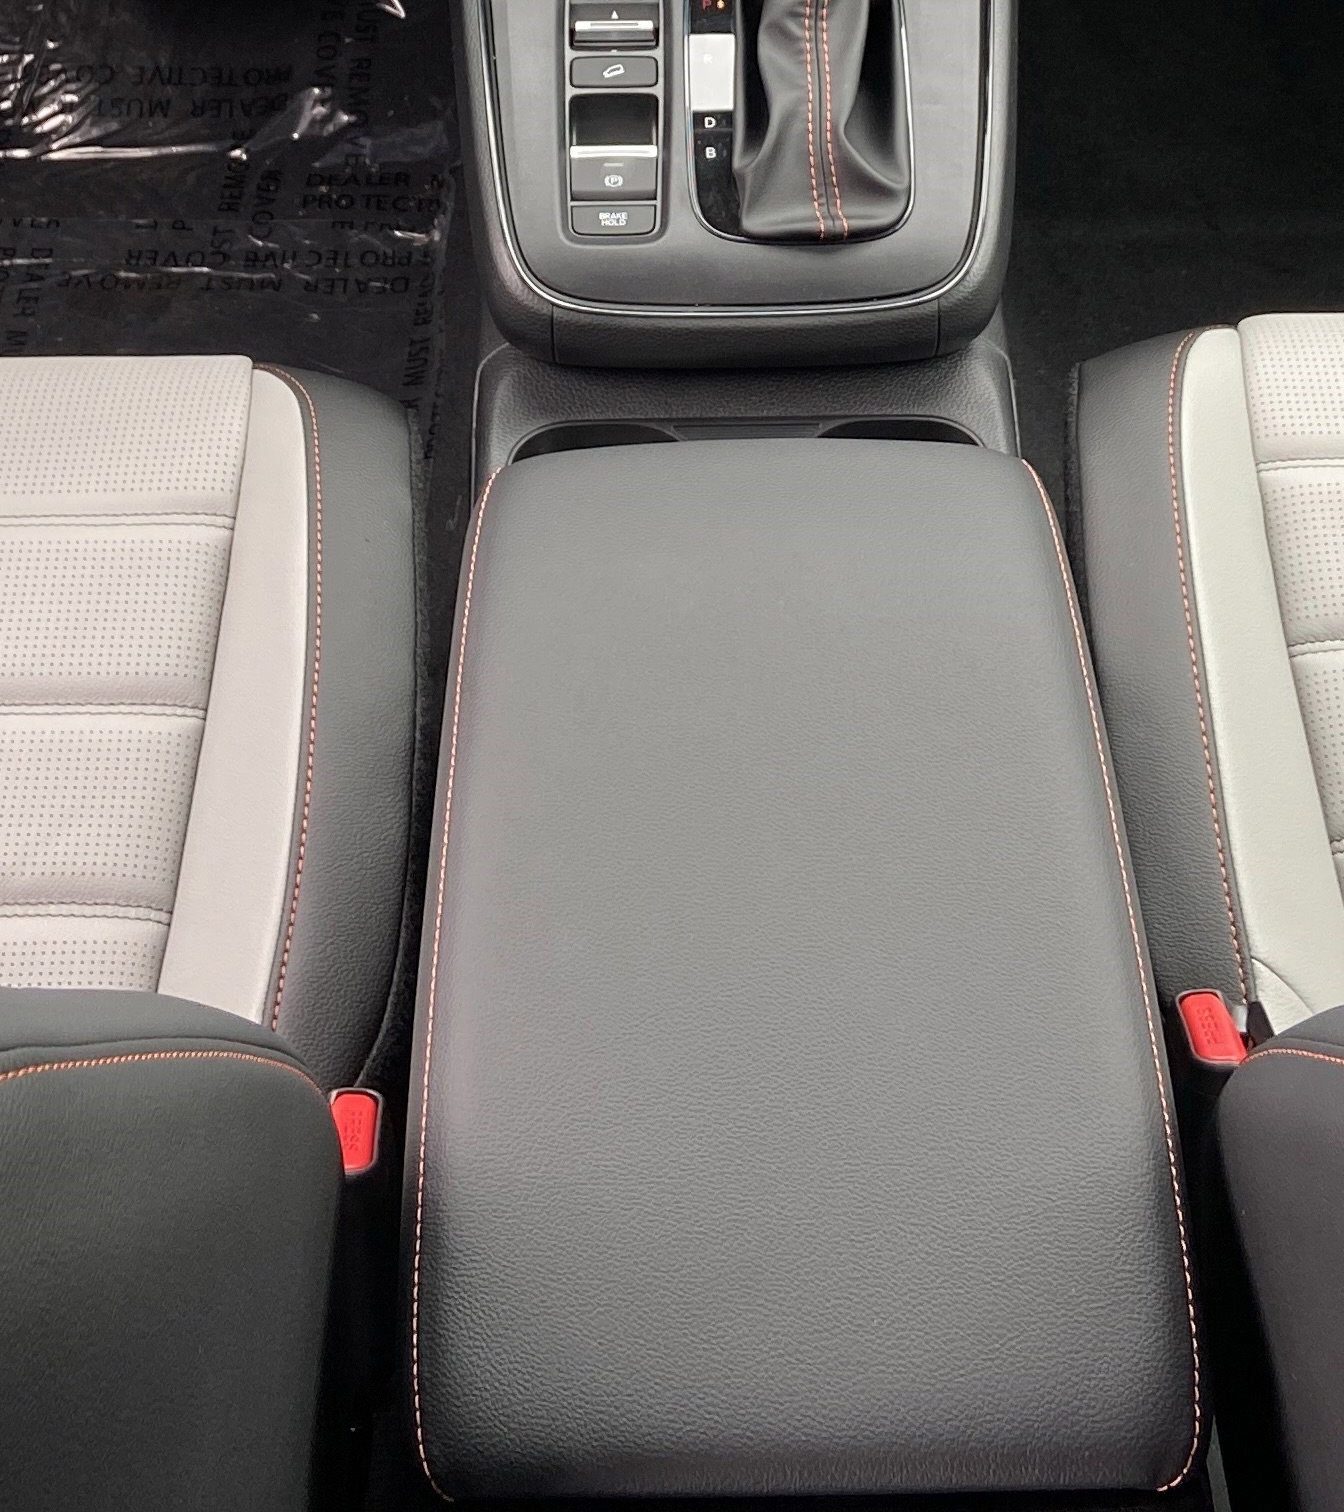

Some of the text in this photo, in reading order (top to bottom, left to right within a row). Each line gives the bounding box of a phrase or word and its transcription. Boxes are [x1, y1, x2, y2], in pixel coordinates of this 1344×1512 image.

[703, 116, 717, 128] D
[705, 146, 717, 159] B
[305, 171, 411, 188] DEALER
[598, 211, 628, 220] BRAKE
[600, 219, 627, 227] HOLD
[125, 249, 231, 268] COVER
[303, 275, 411, 295] DEALER
